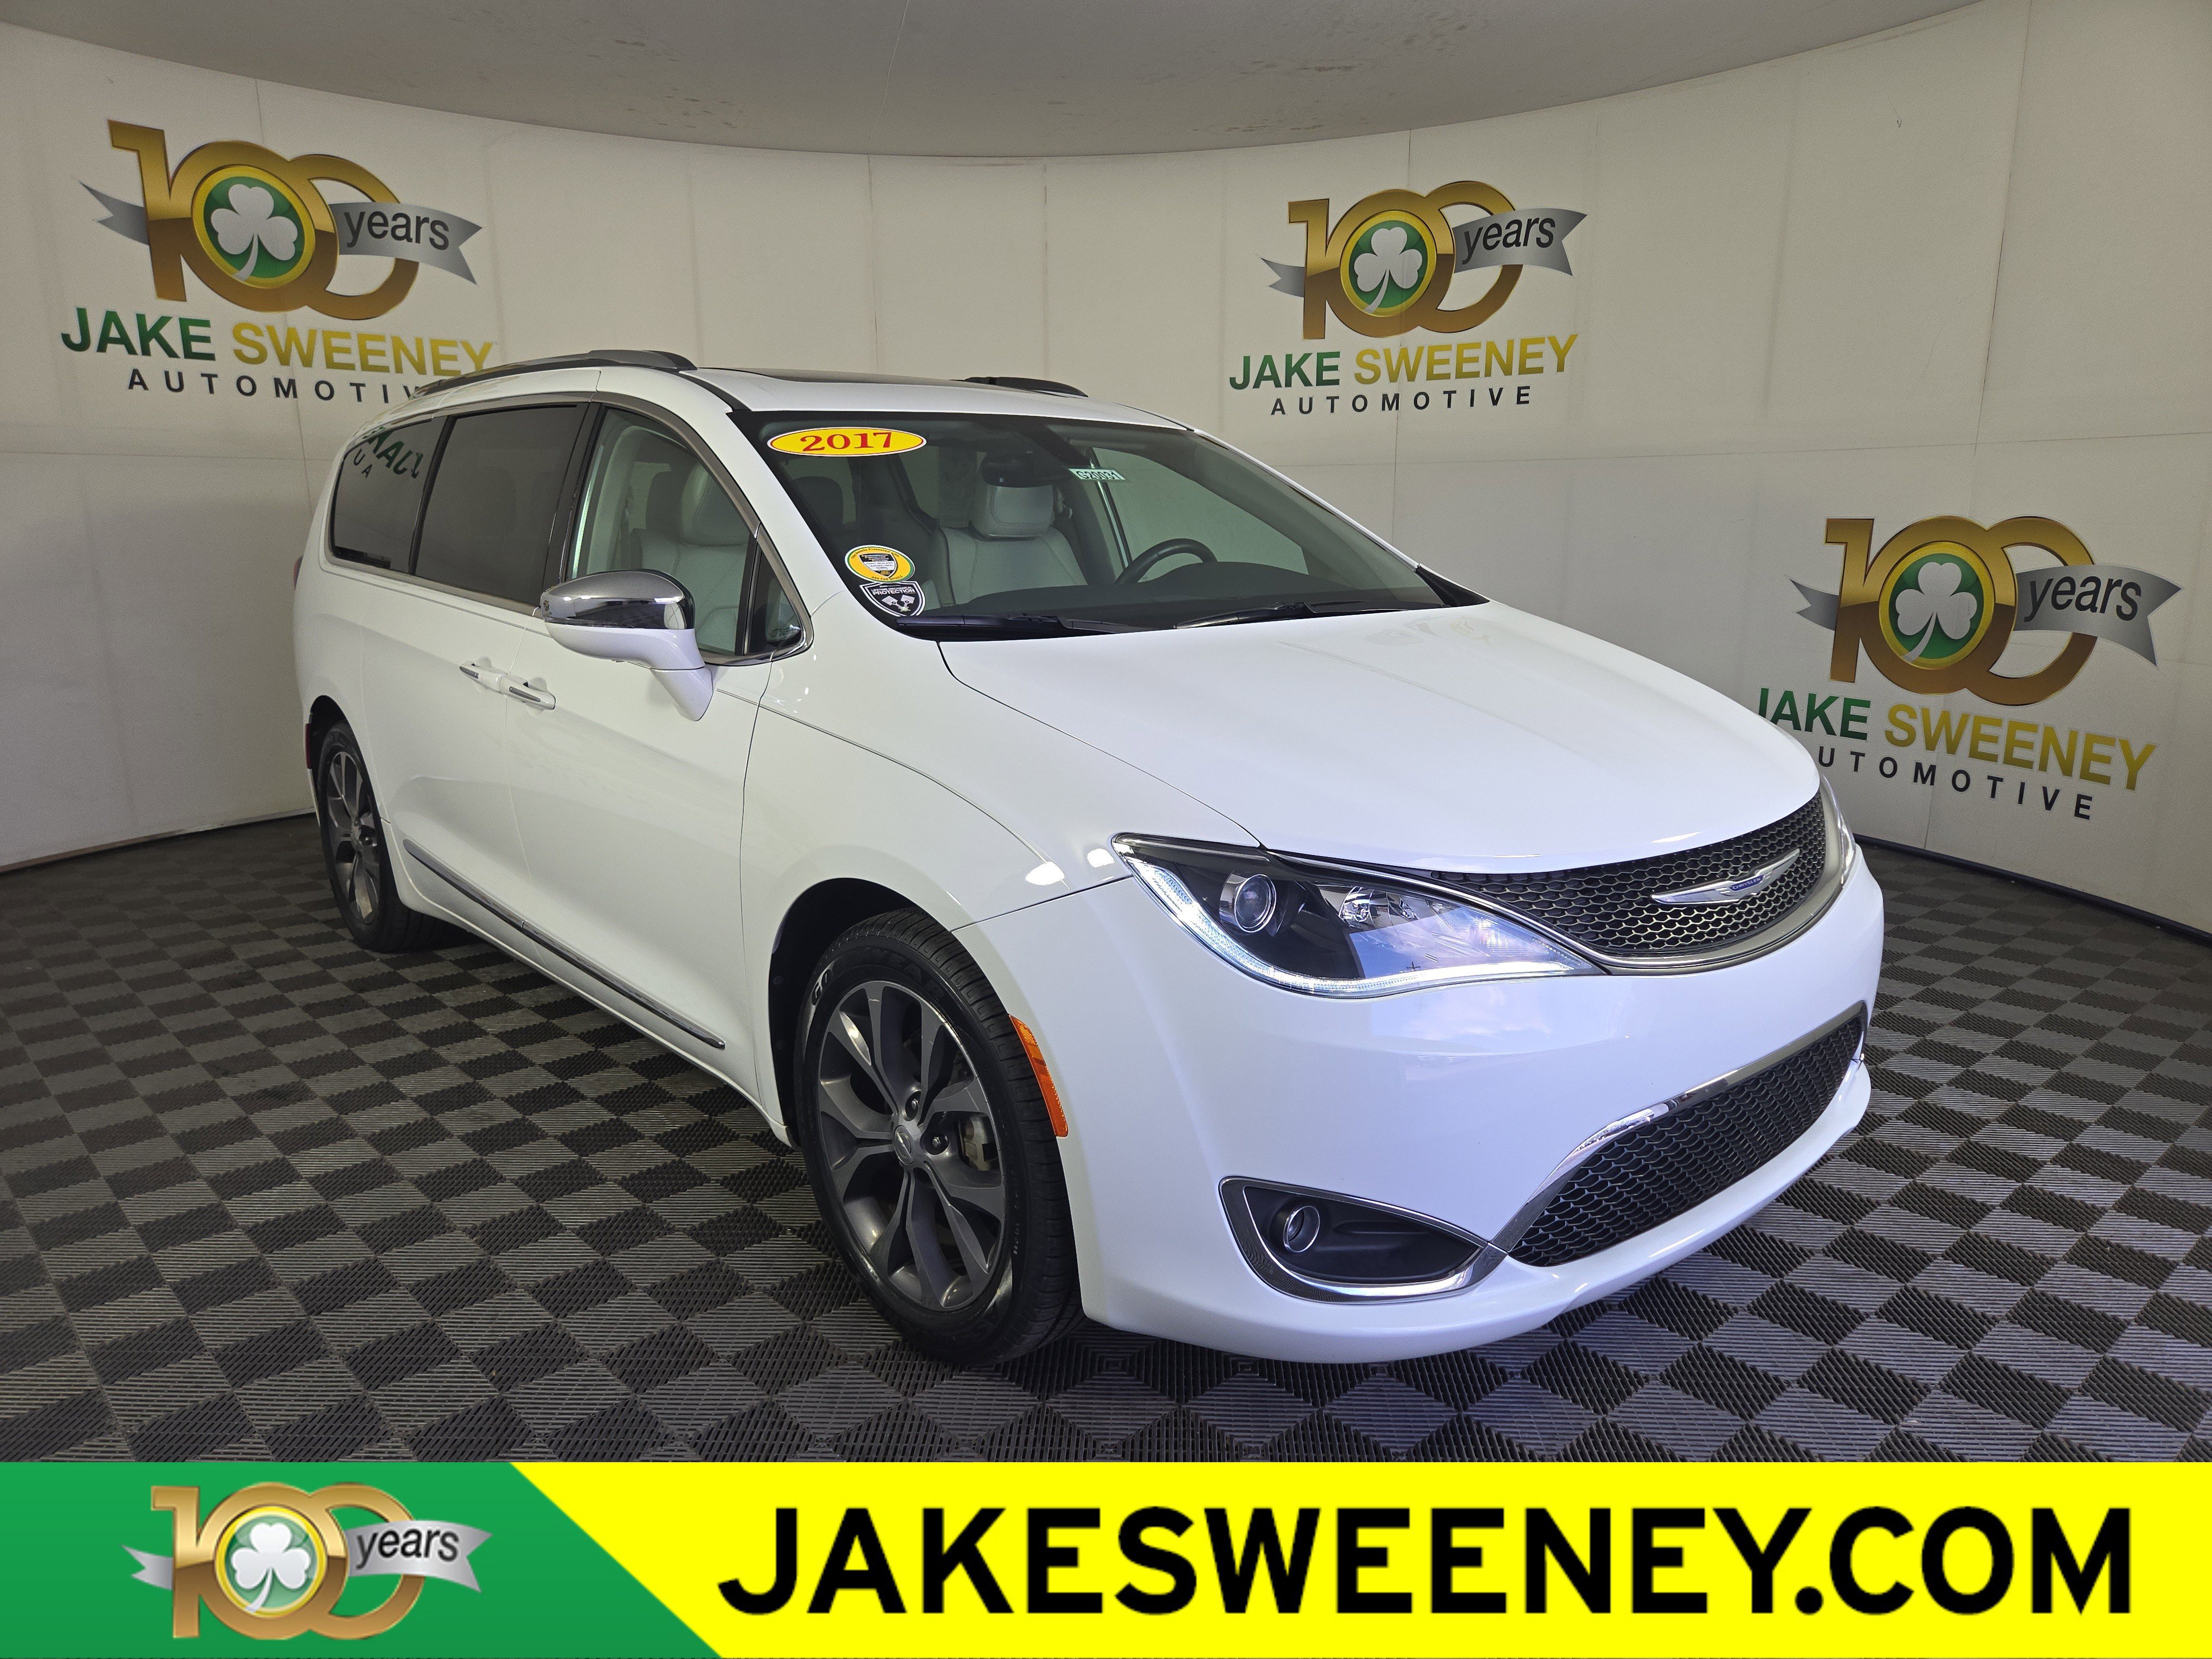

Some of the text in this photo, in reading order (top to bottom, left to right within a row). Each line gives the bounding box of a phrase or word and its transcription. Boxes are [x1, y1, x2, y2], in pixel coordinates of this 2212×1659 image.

[107, 119, 451, 320] 100 years
[1288, 180, 1556, 339] 100 years
[61, 306, 493, 377] JAKE SWEENEY
[1229, 334, 1578, 390] JAKE SWEENEY
[127, 368, 420, 404] AUTOMOTI
[1271, 385, 1531, 415] AUTOMOTIVE
[800, 432, 892, 452] 2017
[1076, 471, 1120, 480] G20031
[1824, 515, 2142, 706] 100 years
[1818, 746, 2093, 820] UTOMOTIVE
[1884, 704, 2157, 792] SWEENEY
